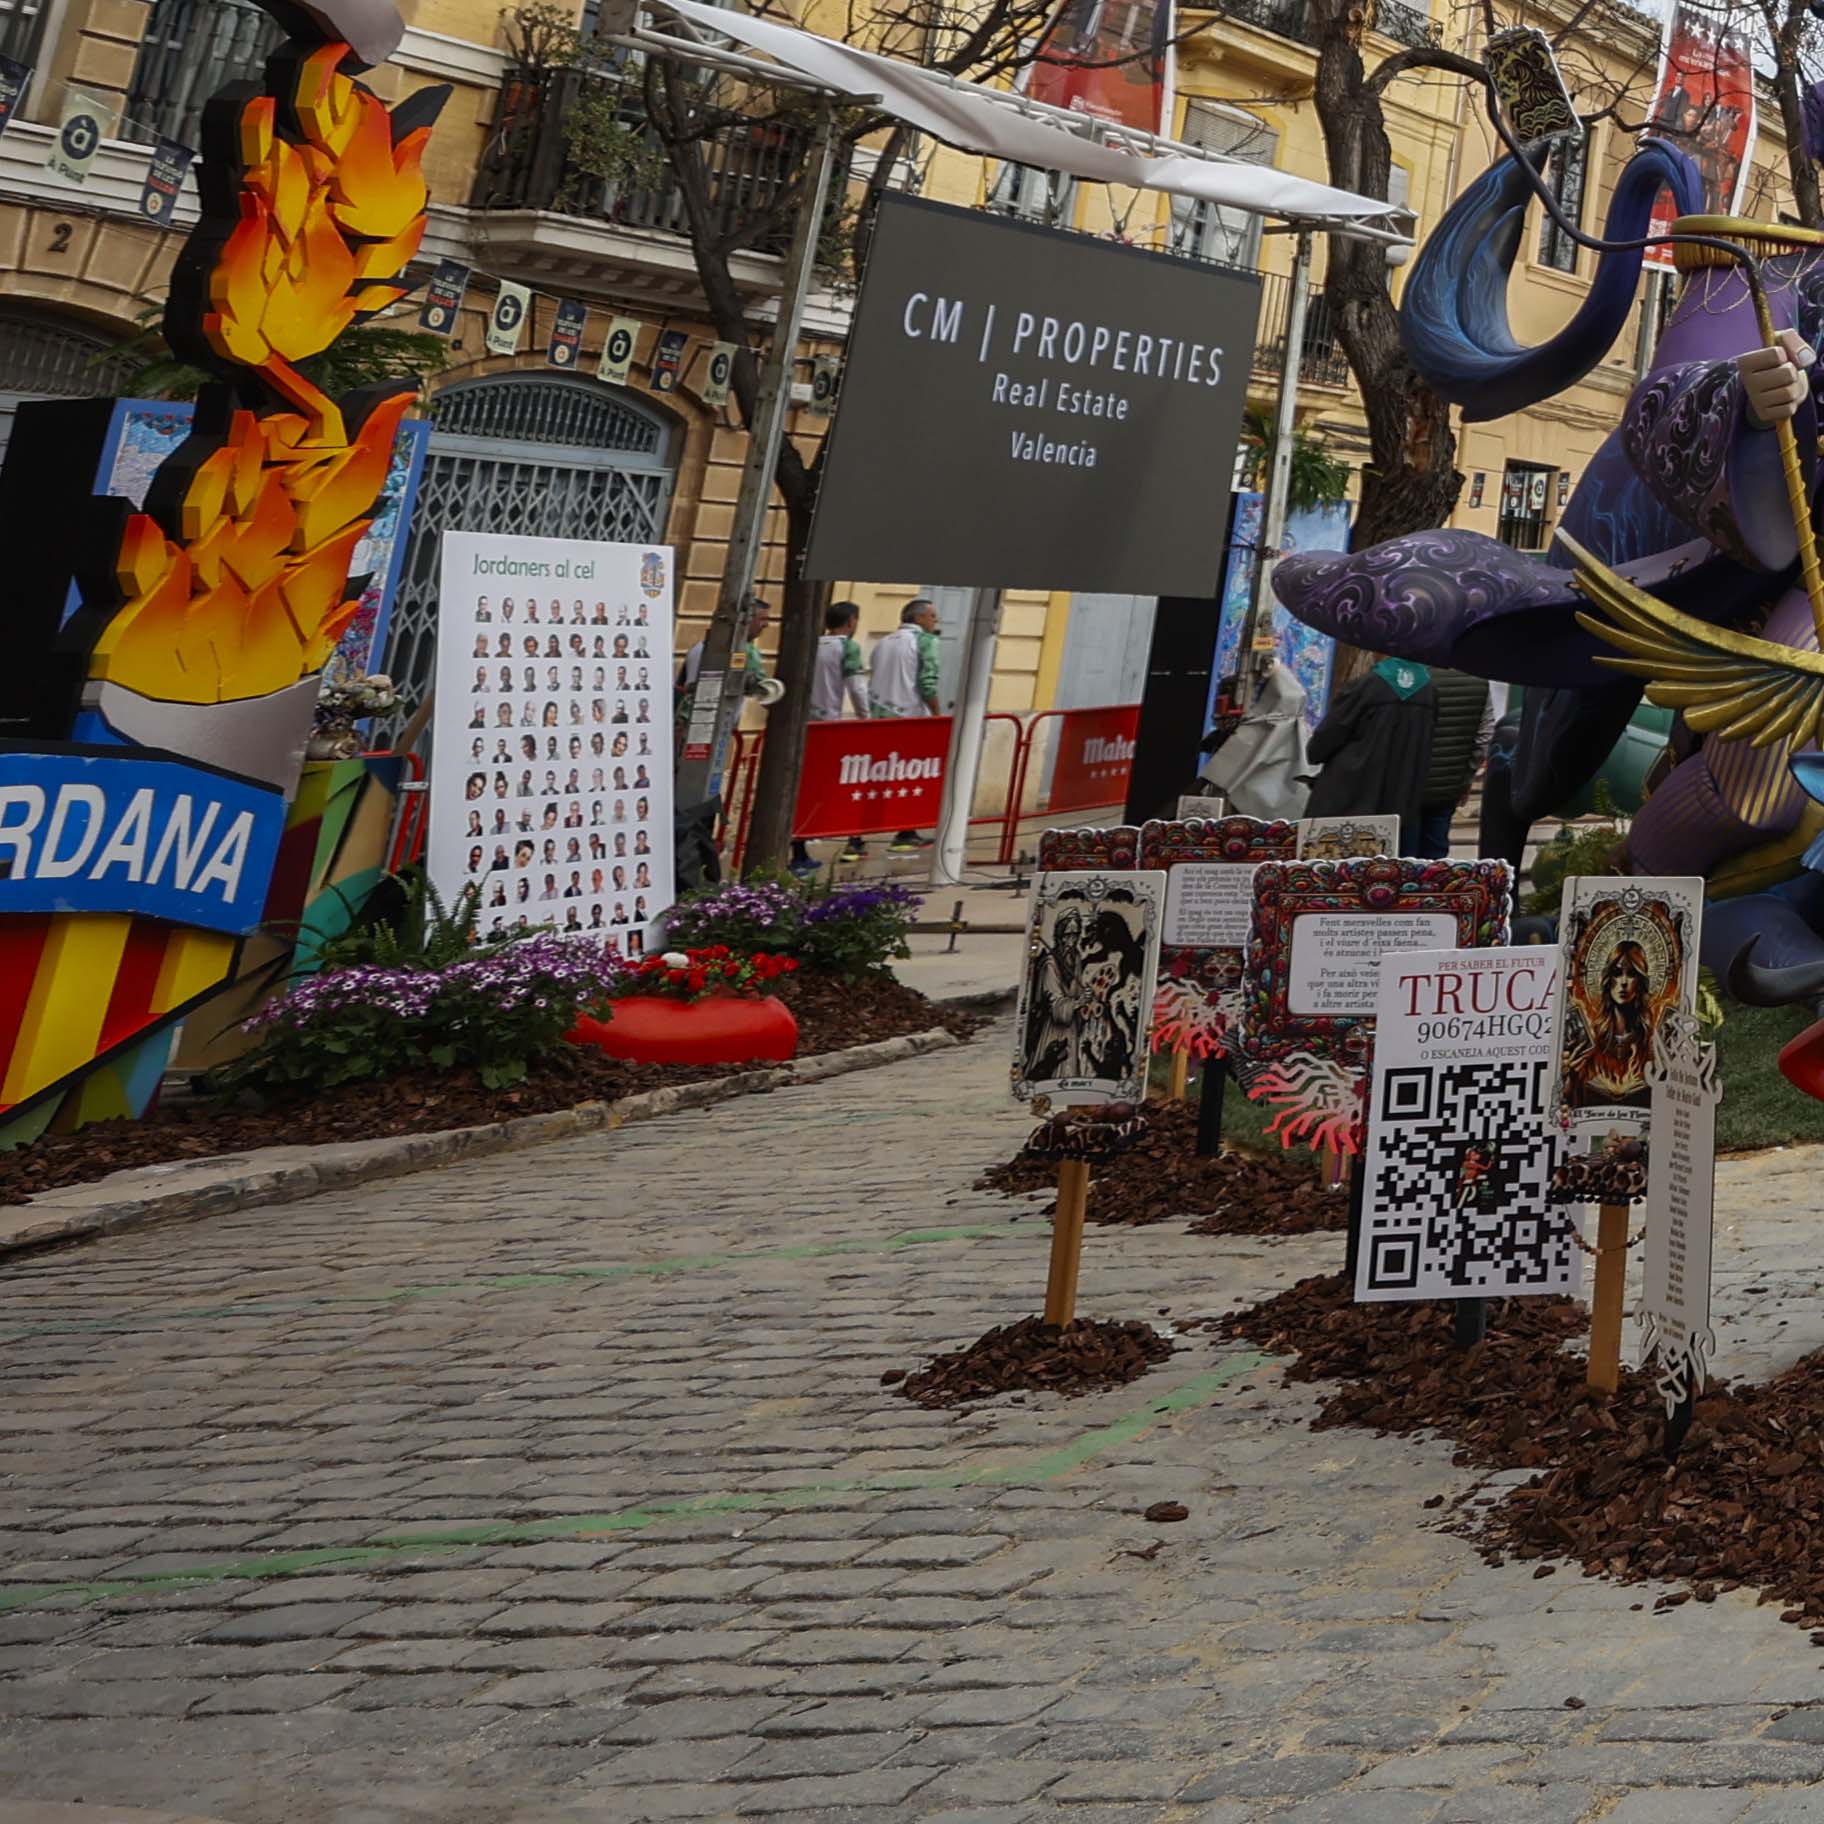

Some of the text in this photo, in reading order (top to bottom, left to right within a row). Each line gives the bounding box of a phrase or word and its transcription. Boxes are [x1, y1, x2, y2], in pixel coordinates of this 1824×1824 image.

[47, 222, 73, 253] 2
[904, 293, 1223, 386] CM PROPERTIES
[992, 373, 1128, 420] Real Estate
[1012, 431, 1096, 467] Valencia
[473, 553, 594, 579] Jordaners al cel
[839, 751, 941, 784] Mahou
[0, 784, 255, 904] RDANA
[1438, 957, 1544, 971] PER SABER EL FUTUR
[1420, 1050, 1429, 1060] O
[1431, 1048, 1483, 1060] ESCANEJA
[1486, 1046, 1526, 1059] AQUEST
